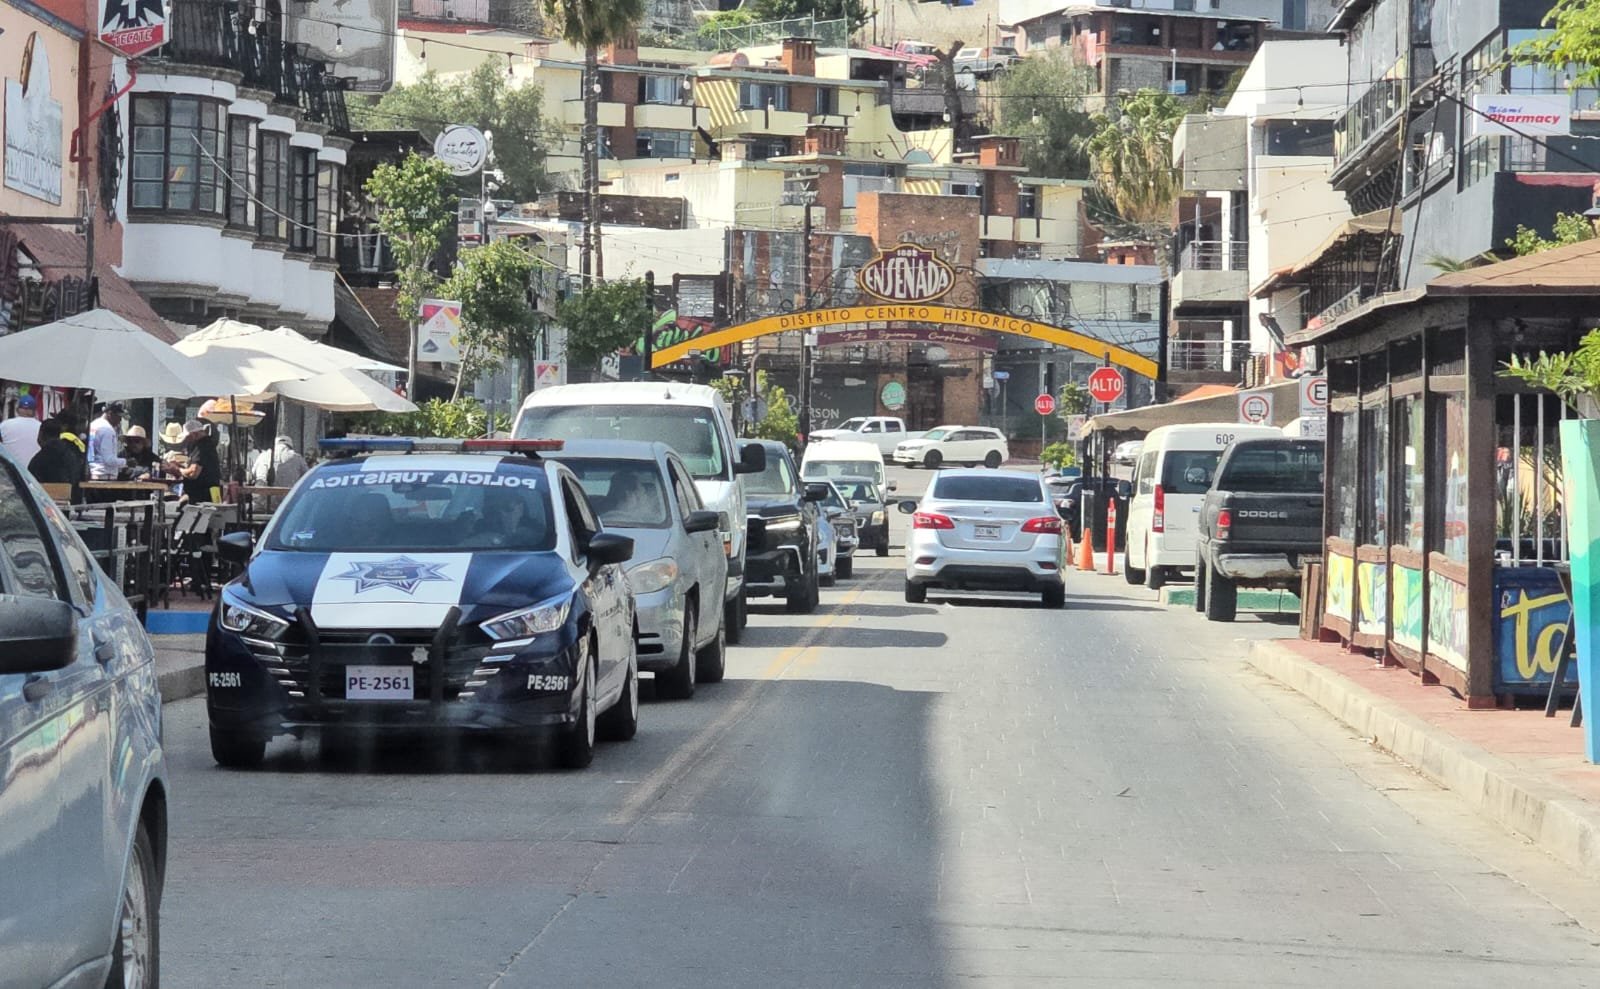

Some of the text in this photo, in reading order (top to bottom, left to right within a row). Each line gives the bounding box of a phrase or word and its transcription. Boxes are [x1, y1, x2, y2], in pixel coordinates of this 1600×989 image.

[112, 28, 153, 47] TECATE
[1486, 105, 1523, 114] Miami
[865, 257, 949, 299] ENSENADA
[780, 306, 1032, 334] DISTRITO CENTRO HISTORICO
[1091, 378, 1121, 392] ALTO
[1037, 400, 1055, 409] ALTO
[1238, 510, 1288, 518] DODGE
[209, 672, 241, 687] PE-2561
[348, 677, 411, 690] PE-2561
[527, 674, 569, 690] PE-2561
